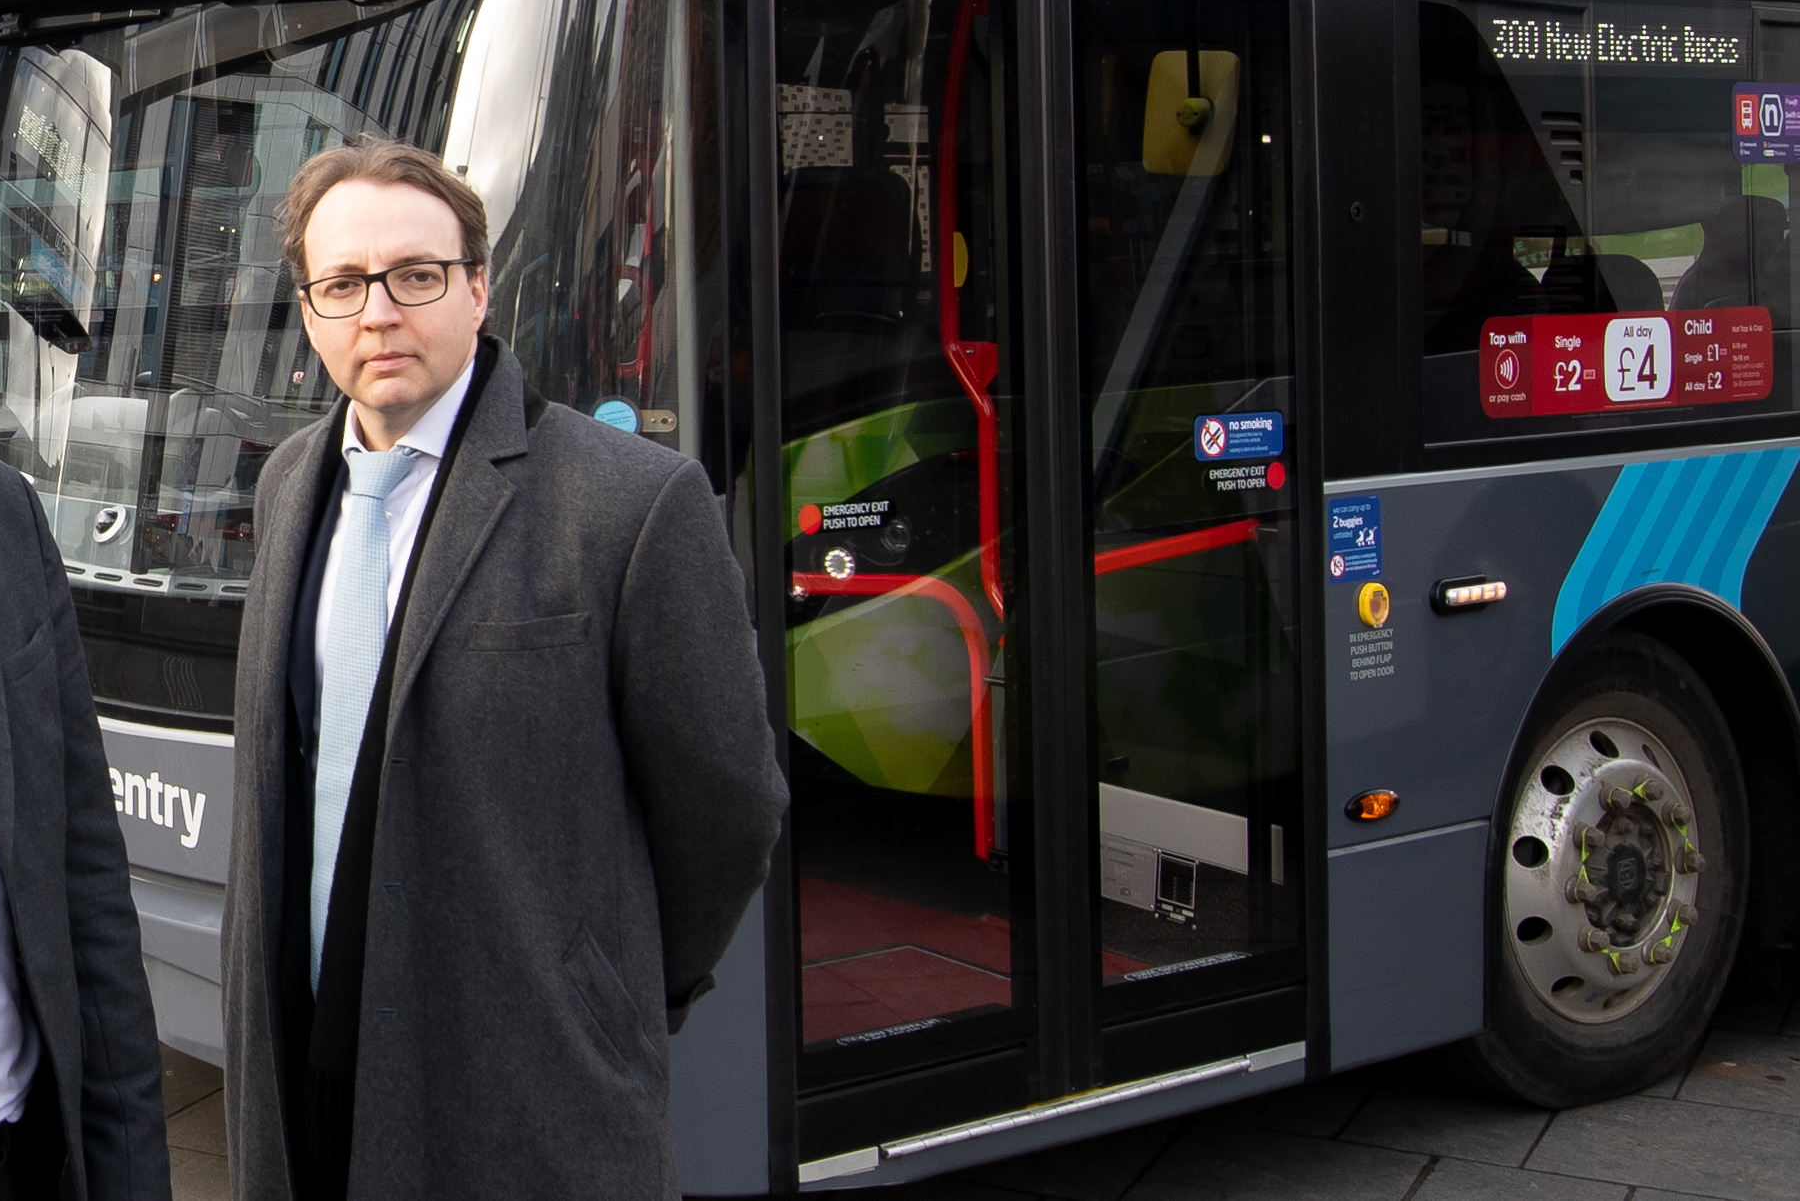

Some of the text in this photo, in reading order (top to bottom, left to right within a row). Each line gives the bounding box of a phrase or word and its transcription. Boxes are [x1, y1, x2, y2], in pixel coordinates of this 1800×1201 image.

[1492, 18, 1740, 64] 300 New Electric Buses
[1623, 324, 1653, 340] All day
[1684, 318, 1713, 336] Child
[1488, 331, 1527, 348] Tap with
[1554, 335, 1582, 352] Single
[1684, 343, 1720, 365] Single £1
[1553, 359, 1582, 392] £2
[1617, 344, 1658, 392] £4
[1684, 382, 1693, 392] All
[1693, 381, 1706, 392] day
[1707, 371, 1723, 390] £2
[1488, 393, 1527, 404] or pay cash
[1228, 416, 1273, 431] no smoking
[1209, 465, 1266, 480] EMERGENCY EXIT
[1217, 478, 1266, 491] PUSH TO OPEN
[823, 500, 890, 517] EMERGENCY EXIT
[823, 515, 881, 530] PUSH TO OPEN
[1333, 515, 1363, 529] 2 buggies
[1349, 628, 1394, 643] IN EMERGENCY
[1350, 641, 1394, 656] PUSH BUTTON
[1351, 653, 1393, 668] BEHIND FLAP
[1349, 665, 1395, 681] TO OPEN DOOR
